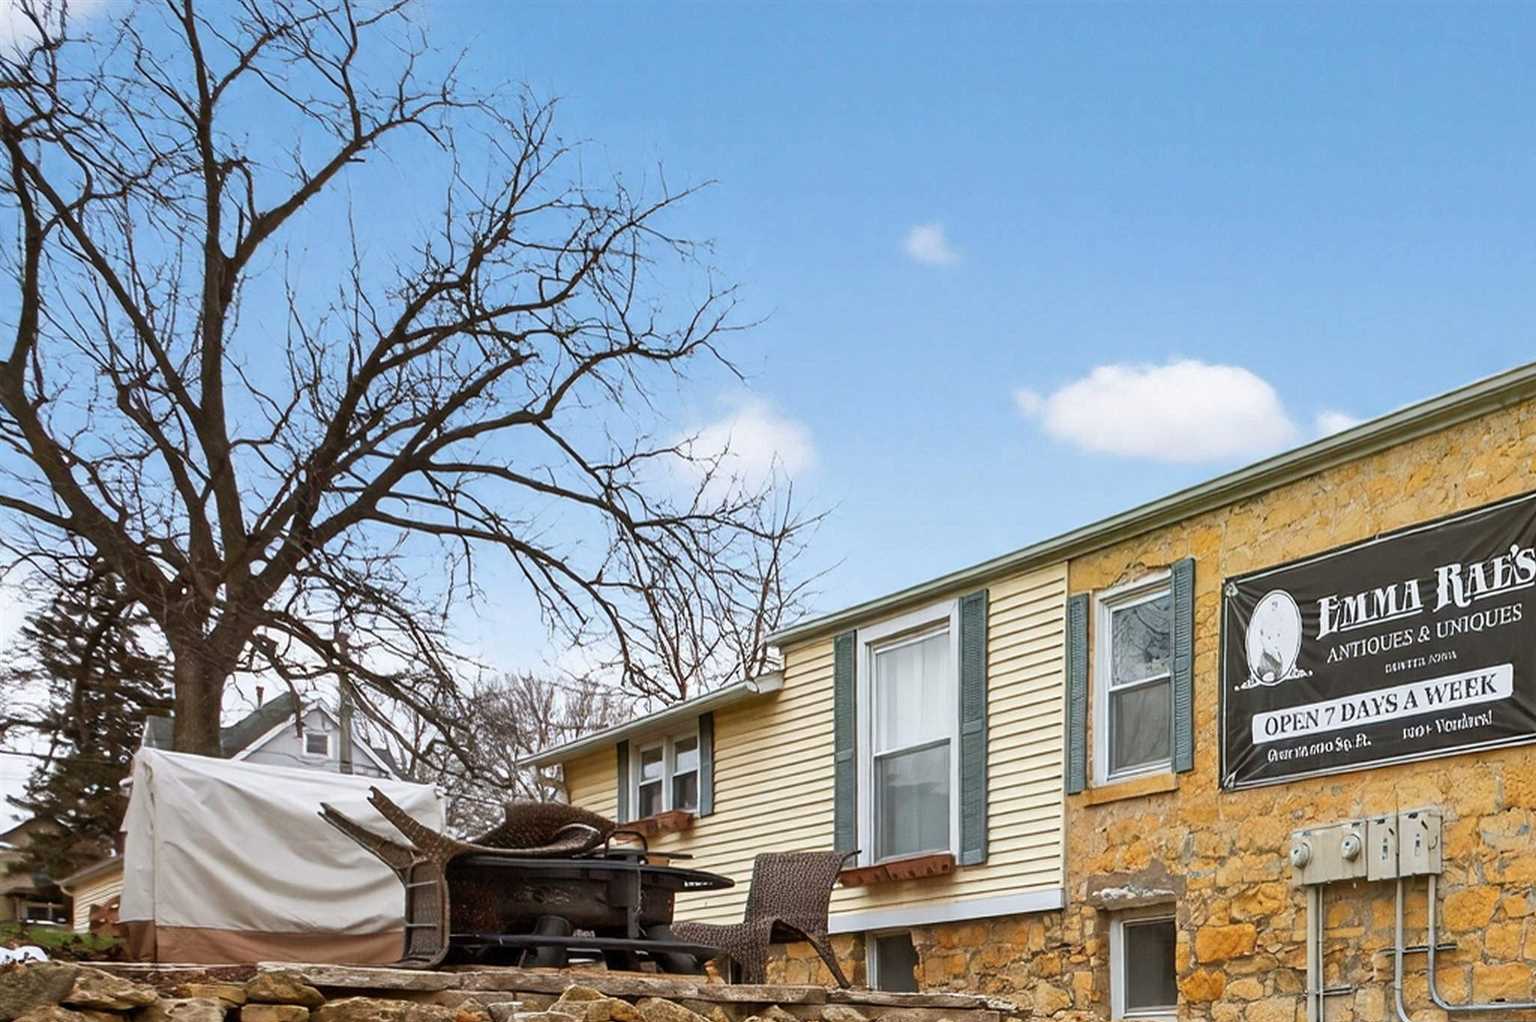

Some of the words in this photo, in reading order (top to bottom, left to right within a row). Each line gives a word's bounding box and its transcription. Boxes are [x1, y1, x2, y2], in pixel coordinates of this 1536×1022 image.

[1316, 579, 1424, 640] EMMA
[1434, 543, 1536, 613] RAE'S
[1327, 627, 1414, 664] ANTIQUES
[1417, 625, 1431, 643] &
[1436, 602, 1523, 639] UNIQUES
[1265, 707, 1320, 737] OPEN
[1324, 706, 1336, 725] 7
[1340, 691, 1399, 723] DAYS
[1403, 693, 1419, 710] A
[1425, 672, 1498, 706] WEEK
